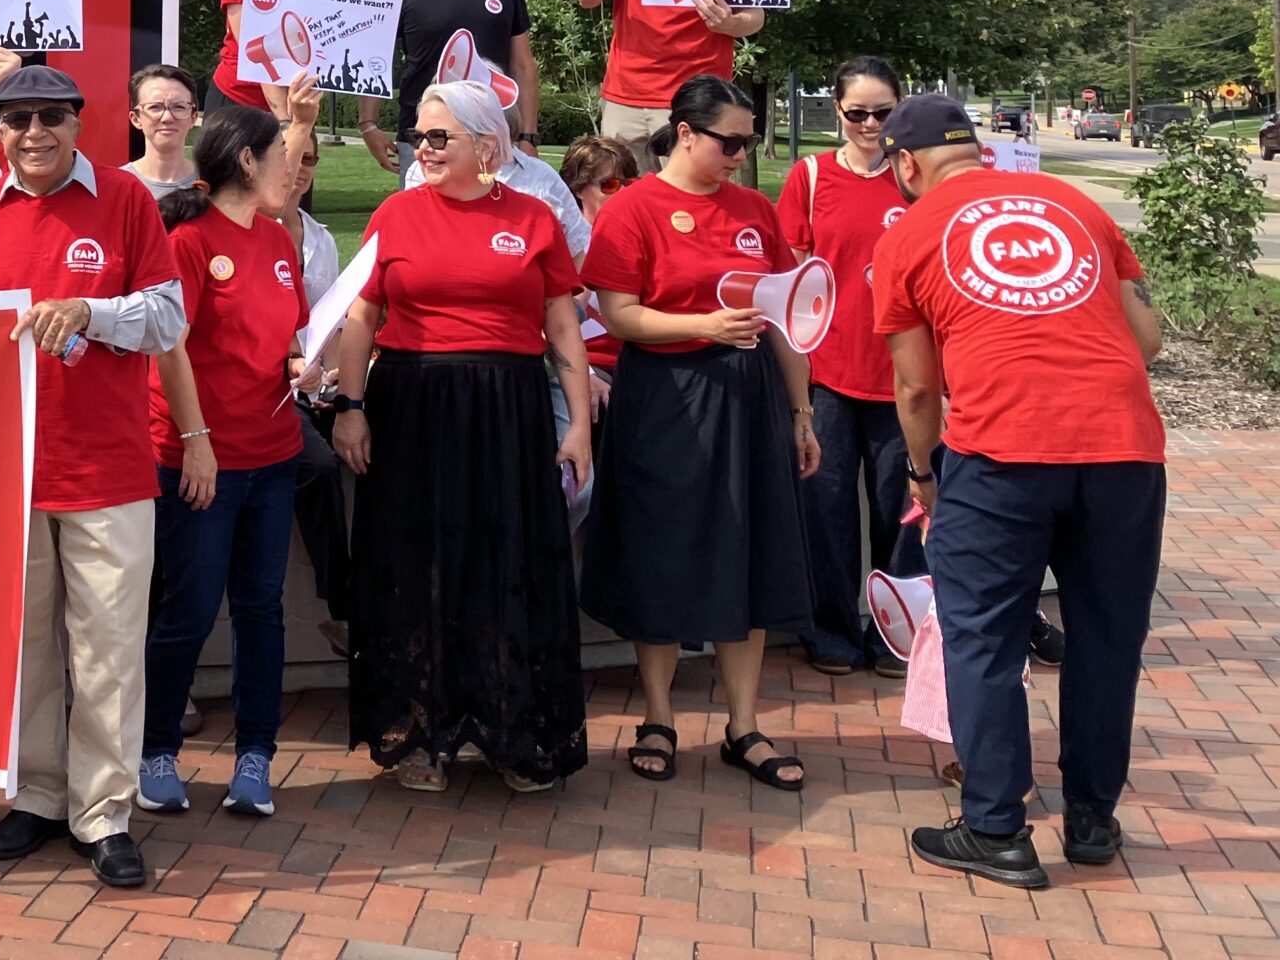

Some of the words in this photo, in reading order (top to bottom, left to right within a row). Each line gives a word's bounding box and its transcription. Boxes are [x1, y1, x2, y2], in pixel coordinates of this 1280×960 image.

[364, 0, 394, 10] want?!
[308, 20, 323, 32] PAY
[324, 10, 343, 23] THAT
[314, 27, 335, 40] KEEPS
[337, 21, 346, 29] UP
[320, 37, 336, 47] WITH
[960, 204, 996, 225] WE
[1002, 200, 1047, 215] ARE
[741, 239, 757, 248] FAM
[989, 237, 1055, 262] FAM
[74, 250, 97, 260] FAM
[961, 267, 998, 299] THE
[1000, 255, 1094, 307] MAJORITY.
